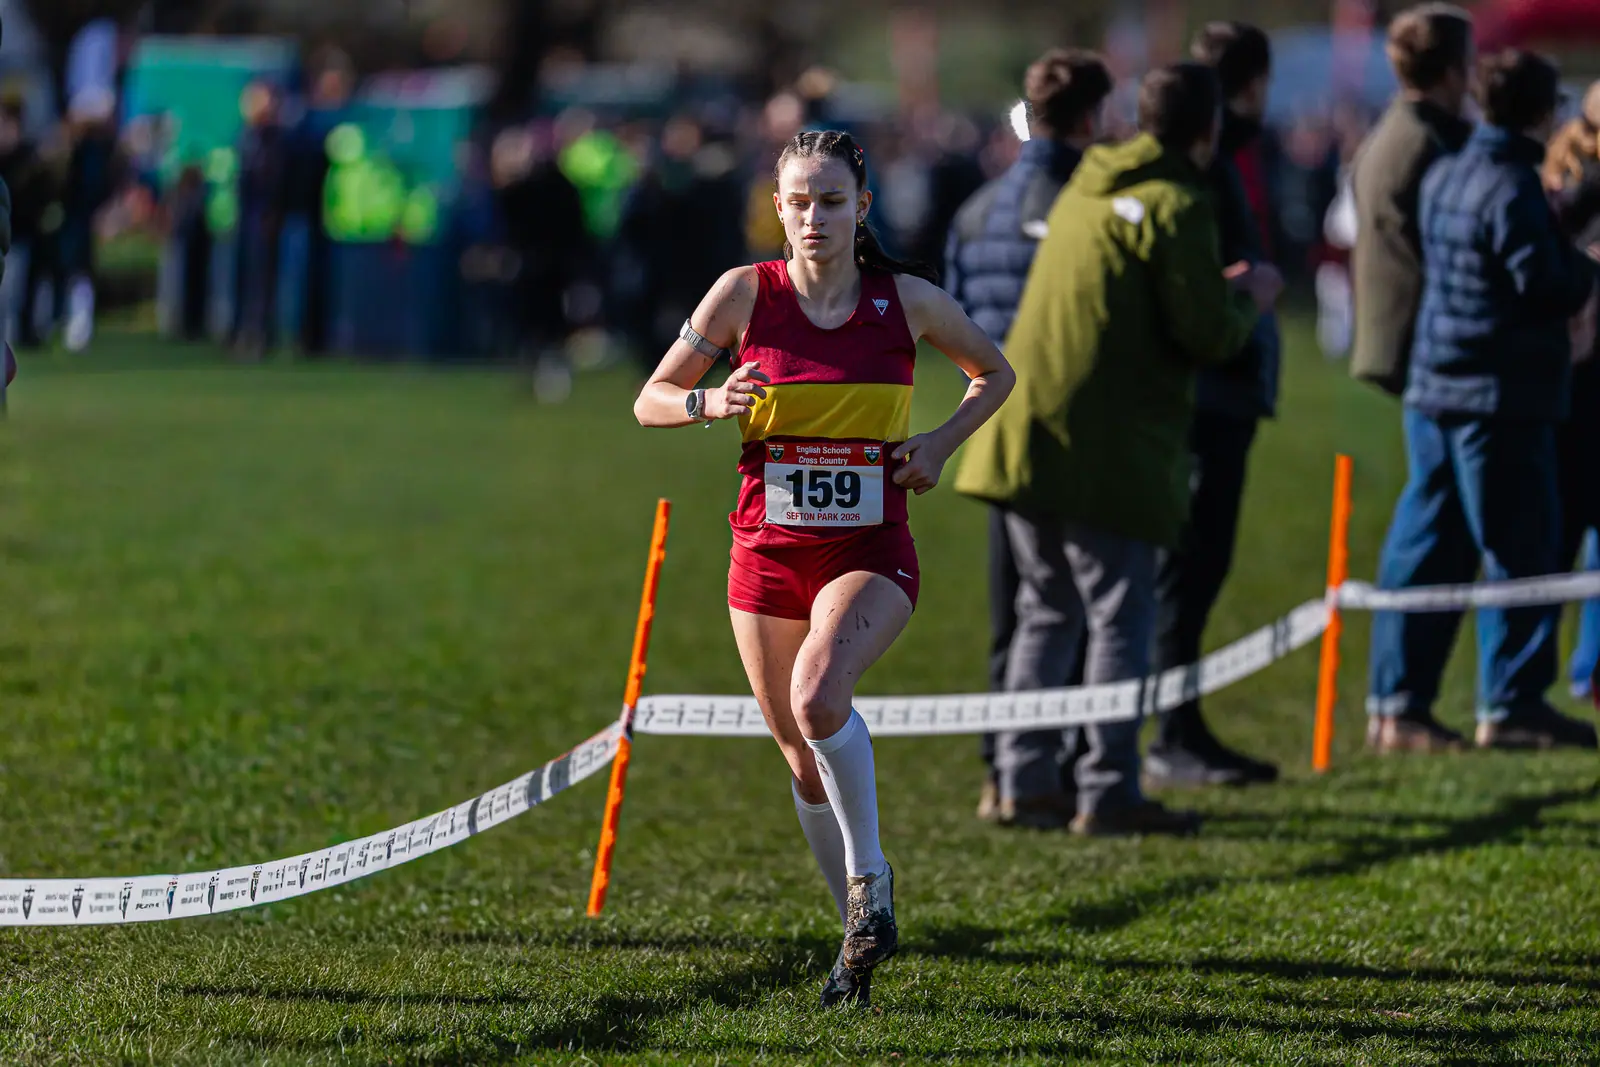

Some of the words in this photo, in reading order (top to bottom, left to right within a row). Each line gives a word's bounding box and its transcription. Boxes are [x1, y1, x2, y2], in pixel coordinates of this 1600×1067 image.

[796, 446, 821, 454] English
[822, 446, 851, 454] Schools
[798, 456, 818, 464] Cross
[819, 457, 848, 466] Country
[786, 470, 861, 508] 159
[786, 512, 815, 521] SEFTON
[817, 513, 838, 521] PARK
[840, 513, 860, 521] 2026
